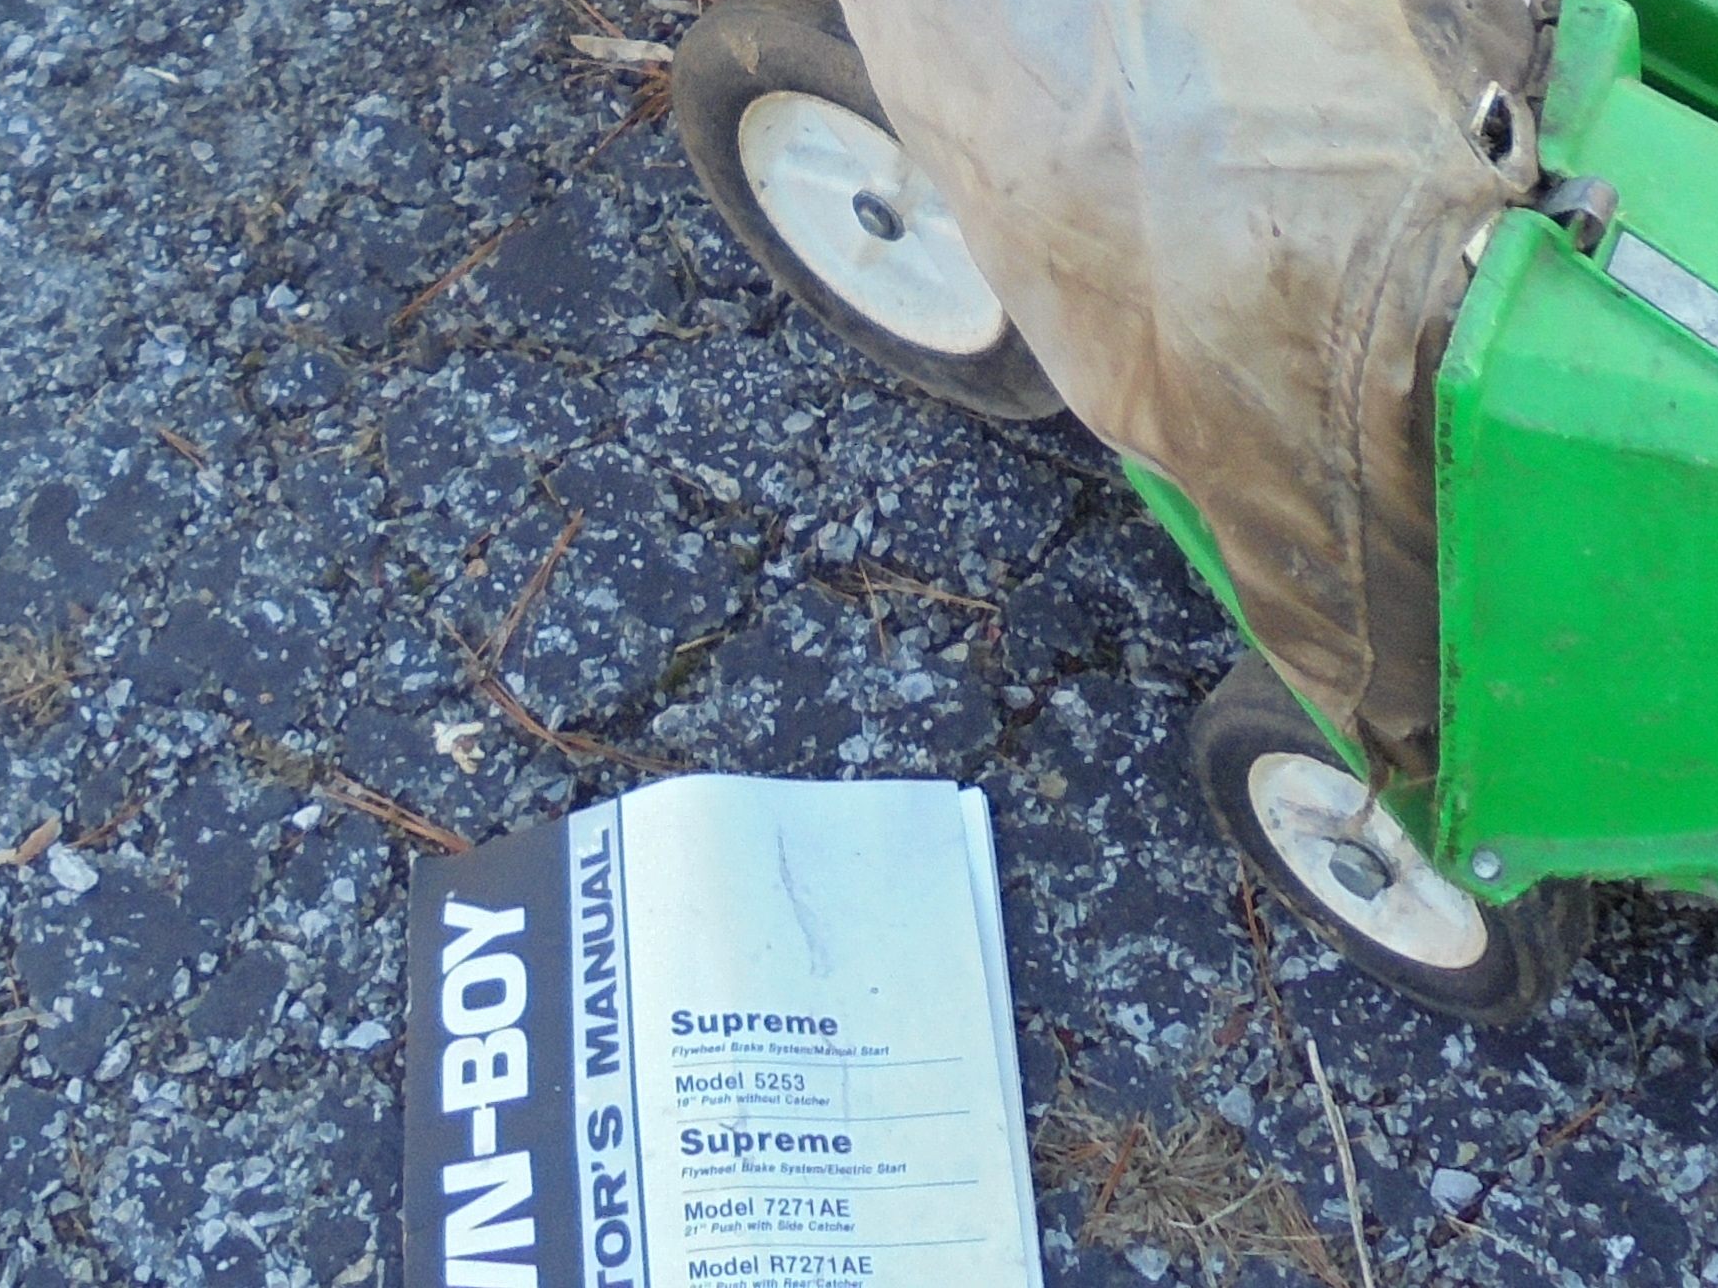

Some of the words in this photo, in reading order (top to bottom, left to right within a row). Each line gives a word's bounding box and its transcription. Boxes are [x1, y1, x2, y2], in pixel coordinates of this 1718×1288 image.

[580, 827, 621, 1079] MANUAL
[671, 1009, 839, 1038] Supreme
[671, 1042, 726, 1058] Flywheel
[731, 1042, 764, 1053] Brake
[861, 1045, 890, 1056] Start
[675, 1072, 744, 1094] Model
[754, 1072, 805, 1092] 5253
[701, 1094, 732, 1106] Push
[736, 1093, 781, 1104] without
[785, 1094, 831, 1107] Catcher
[680, 1127, 853, 1157] Supreme
[681, 1163, 737, 1179] Flywheel
[741, 1161, 776, 1174] Brake
[780, 1162, 873, 1176] System/Electric
[877, 1162, 907, 1175] Start
[684, 1197, 755, 1222] Model
[763, 1198, 851, 1218] 7271AE
[711, 1222, 743, 1234] Push
[747, 1221, 773, 1232] with
[777, 1221, 804, 1232] Side
[808, 1221, 856, 1233] Catcher
[689, 1254, 759, 1280] Model
[770, 1255, 874, 1275] R7271AE
[752, 1278, 778, 1288] with
